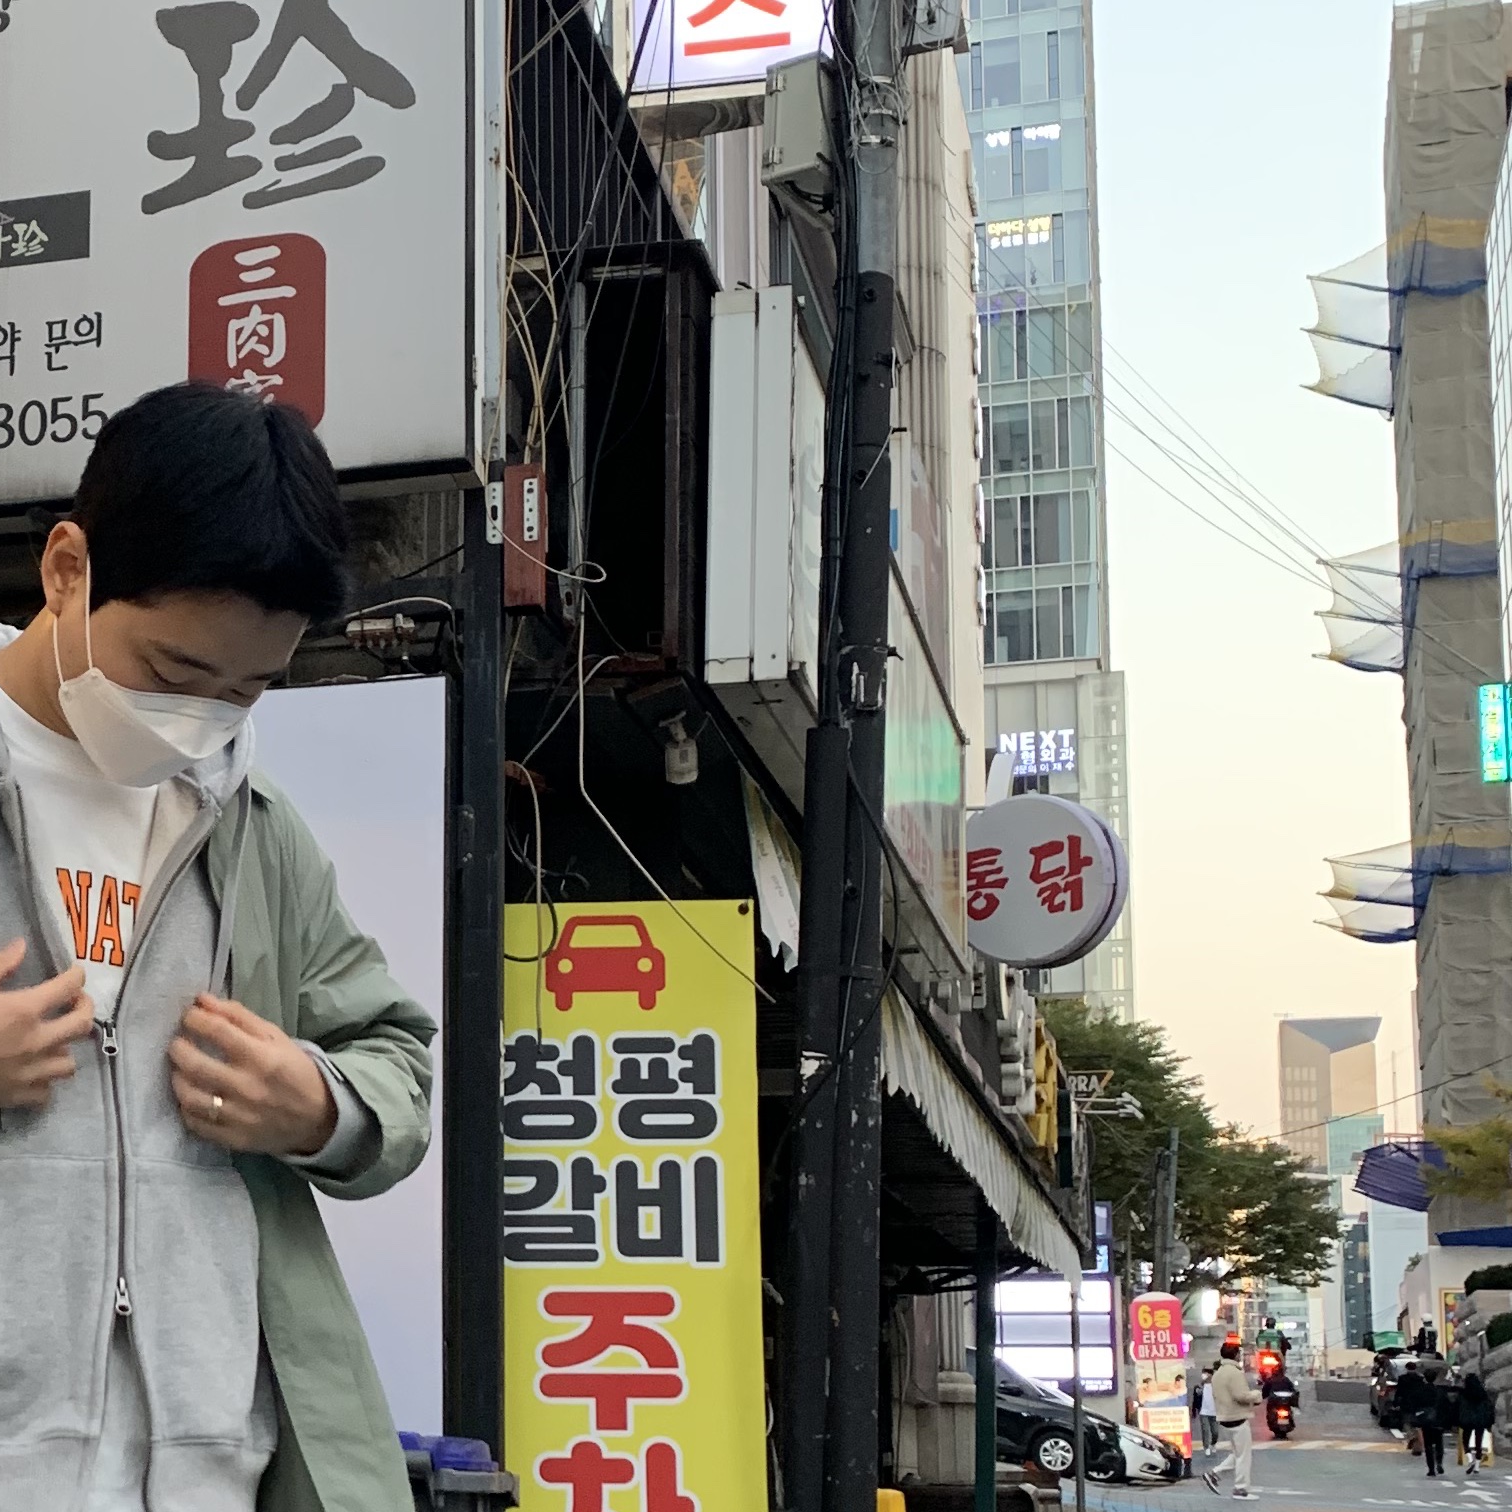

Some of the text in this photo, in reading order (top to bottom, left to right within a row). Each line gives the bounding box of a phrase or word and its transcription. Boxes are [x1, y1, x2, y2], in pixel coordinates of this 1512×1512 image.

[43, 311, 103, 372] 문의
[999, 728, 1075, 753] NEXT
[1004, 747, 1076, 765] 형외과
[967, 834, 1094, 921] 통닭
[504, 1033, 718, 1140] 청평
[504, 1156, 720, 1263] 갈비
[1138, 1343, 1179, 1359] 마사지
[1142, 1330, 1172, 1344] 타이
